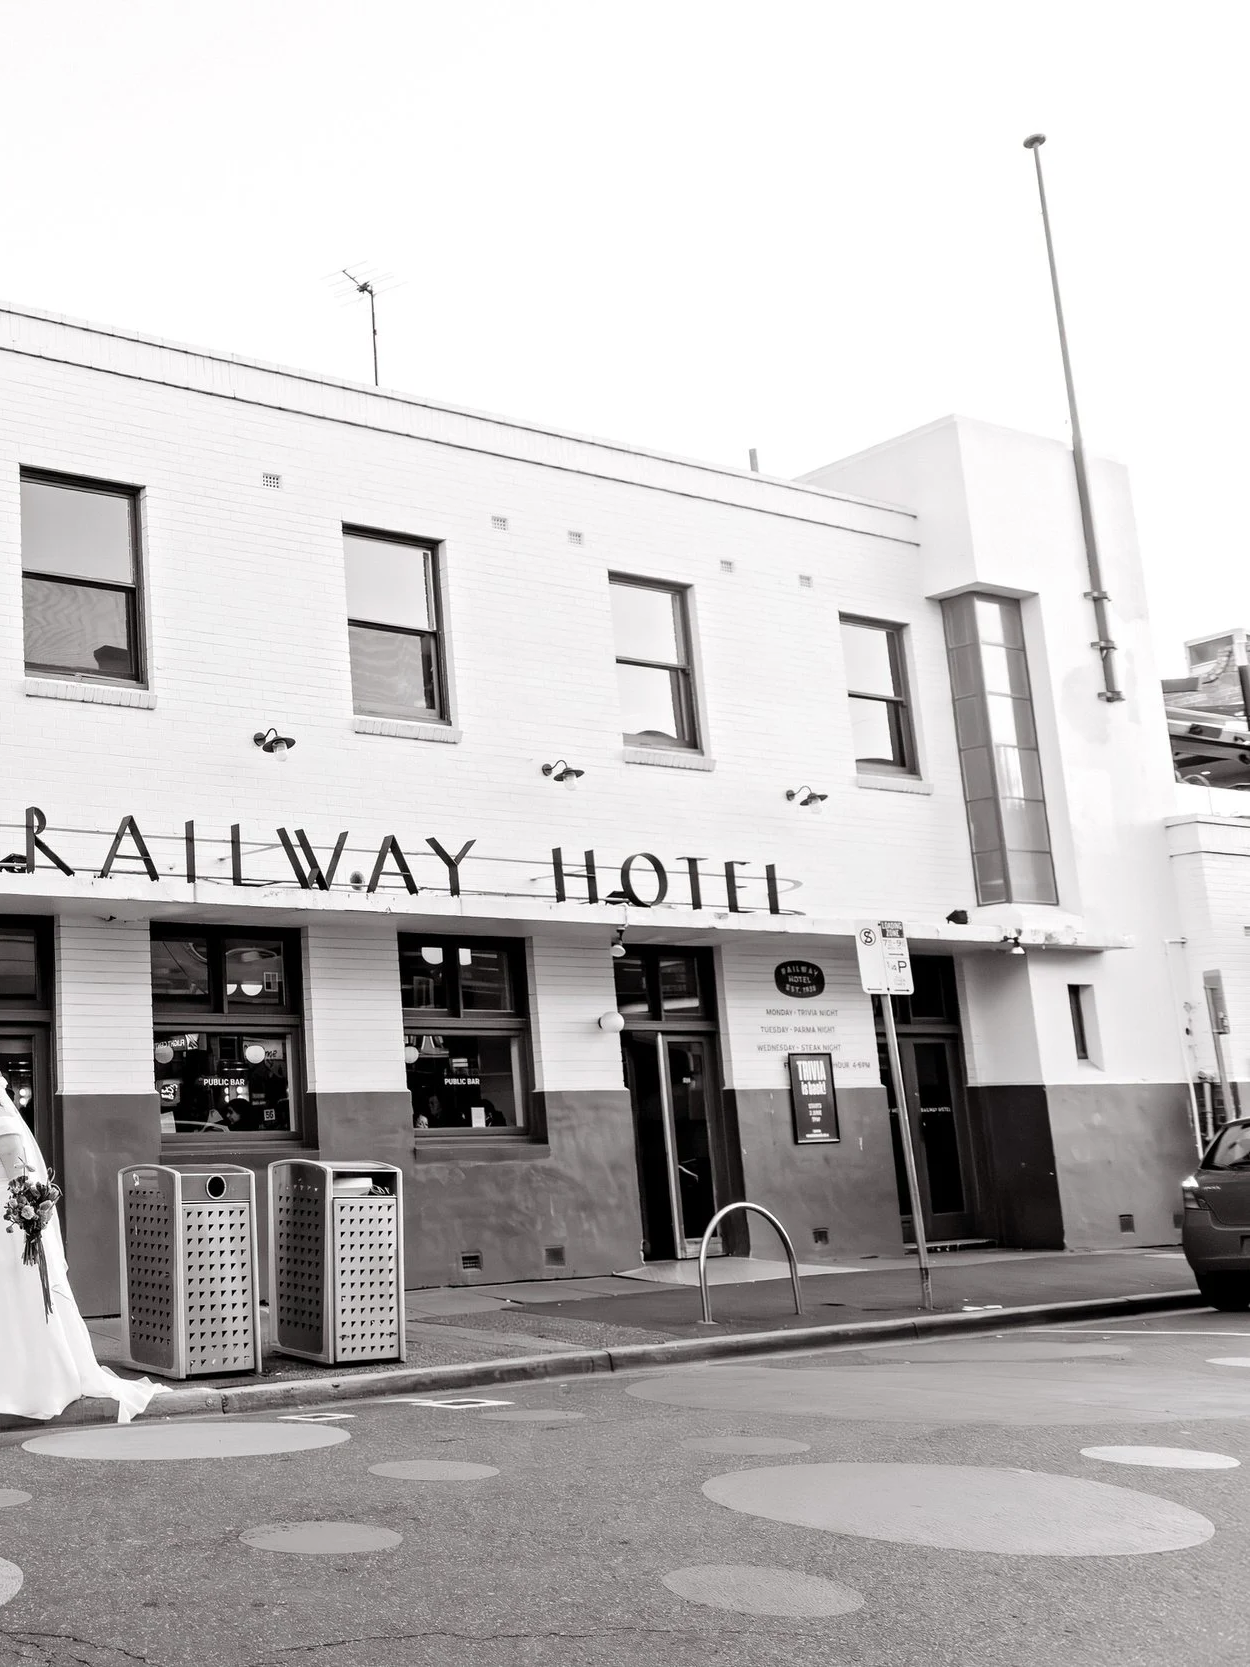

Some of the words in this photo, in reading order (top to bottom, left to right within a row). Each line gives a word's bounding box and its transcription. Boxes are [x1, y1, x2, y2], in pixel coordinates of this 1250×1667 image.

[25, 806, 476, 897] RAILWAY
[551, 847, 806, 915] HOTEL
[781, 965, 819, 978] RAILWAY
[788, 976, 811, 984] HOTEL
[796, 1060, 827, 1081] TRIVIA
[203, 1078, 230, 1086] PUBLIC
[230, 1078, 245, 1086] BAR
